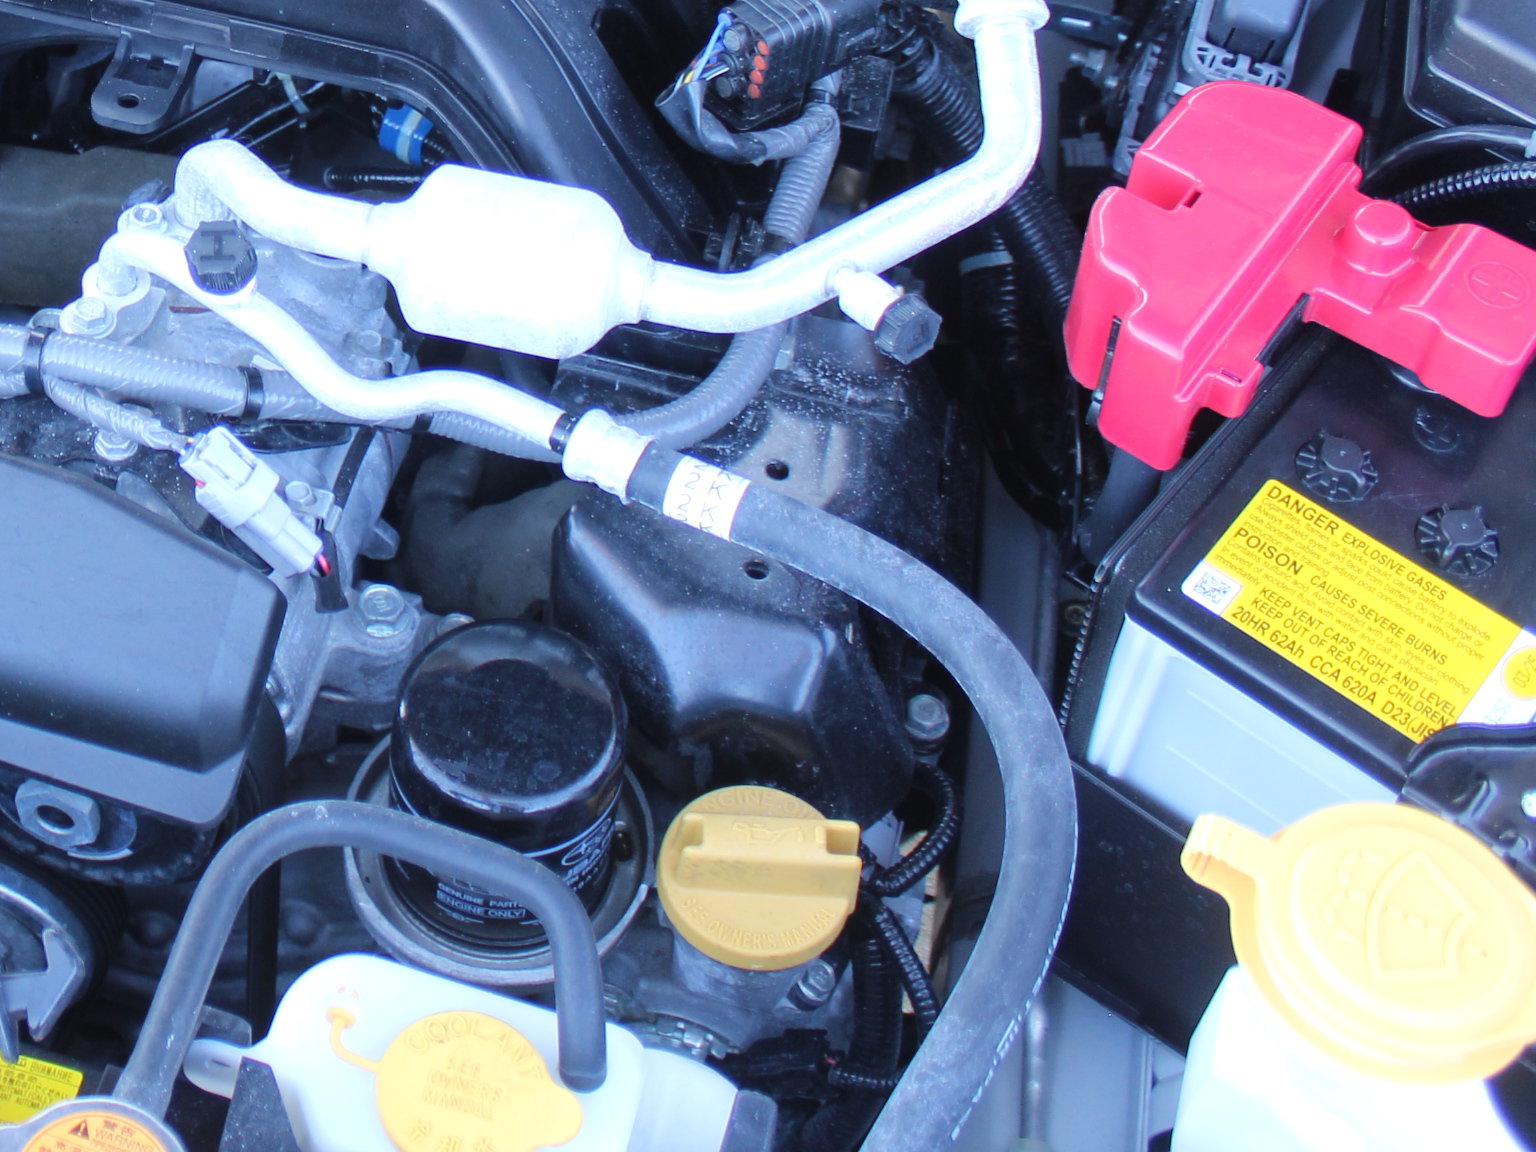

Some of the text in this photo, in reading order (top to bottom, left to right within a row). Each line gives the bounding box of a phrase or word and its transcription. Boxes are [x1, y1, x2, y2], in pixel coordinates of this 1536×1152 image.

[1266, 484, 1341, 536] DANGER
[1232, 526, 1304, 576] POISON
[1340, 531, 1448, 601] EXPLOSIVE GASES
[1249, 596, 1284, 623] KEEP
[1280, 616, 1309, 639] OUT
[1306, 632, 1327, 650] OF
[1325, 644, 1370, 677] REACH
[1366, 670, 1388, 689] OF
[1258, 585, 1292, 611] KEEP
[1290, 605, 1324, 631] VENT
[1321, 625, 1357, 652] CAPS
[1356, 647, 1393, 675] TIGHT
[1391, 669, 1420, 692] AND
[1418, 686, 1460, 717] LEVEL
[1308, 573, 1449, 666] CAUSES SEVERE BURNS
[1230, 604, 1272, 637] 20HR
[1267, 628, 1308, 659] 62Ah
[1307, 653, 1344, 683] CCA
[1339, 673, 1380, 706] 620A
[436, 889, 485, 916] ENGINE
[487, 908, 522, 919] ONLY
[437, 881, 523, 909] GENUINE PART
[680, 896, 838, 950] SEE OWNER'S MANUAL
[405, 1013, 544, 1081] COOLANT
